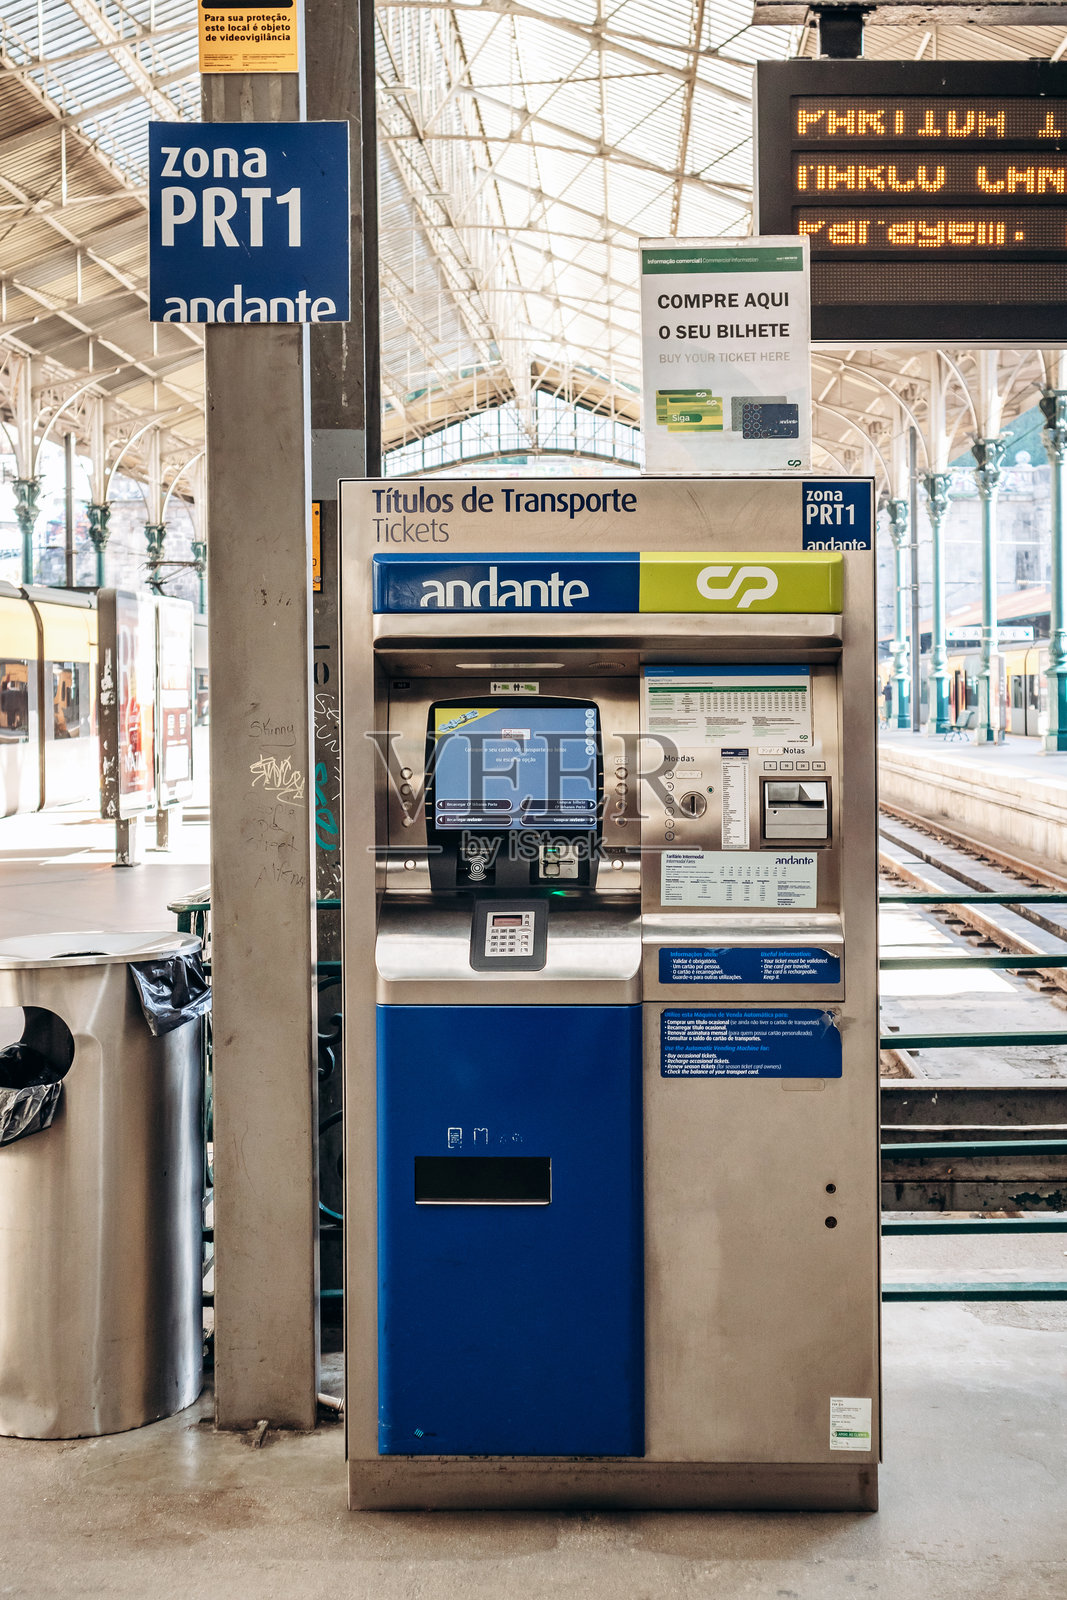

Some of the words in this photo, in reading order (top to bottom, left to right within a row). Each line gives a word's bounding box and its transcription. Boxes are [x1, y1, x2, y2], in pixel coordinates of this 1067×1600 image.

[205, 14, 225, 22] Para
[247, 13, 291, 23] proteção,
[253, 23, 258, 31] é
[261, 24, 291, 32] objeto
[220, 33, 291, 42] videovigilância
[161, 146, 268, 178] zona
[162, 187, 302, 247] PRT1
[163, 284, 337, 322] andante
[658, 293, 739, 309] COMPRE
[744, 292, 789, 309] AQUI
[659, 326, 670, 339] O
[676, 325, 711, 339] SEU
[718, 324, 790, 338] BILHETE
[660, 354, 681, 364] BUY
[685, 353, 715, 363] YOUR
[719, 352, 756, 362] TICKET
[761, 352, 790, 361] HERE
[672, 414, 690, 423] Siga
[372, 486, 454, 513] Títulos
[462, 486, 494, 512] de
[501, 488, 637, 519] Transporte
[807, 490, 843, 501] zona
[807, 504, 854, 525] PRT1
[372, 516, 450, 543] Tickets
[807, 537, 867, 550] andante
[420, 567, 590, 607] andante
[775, 856, 814, 865] andante
